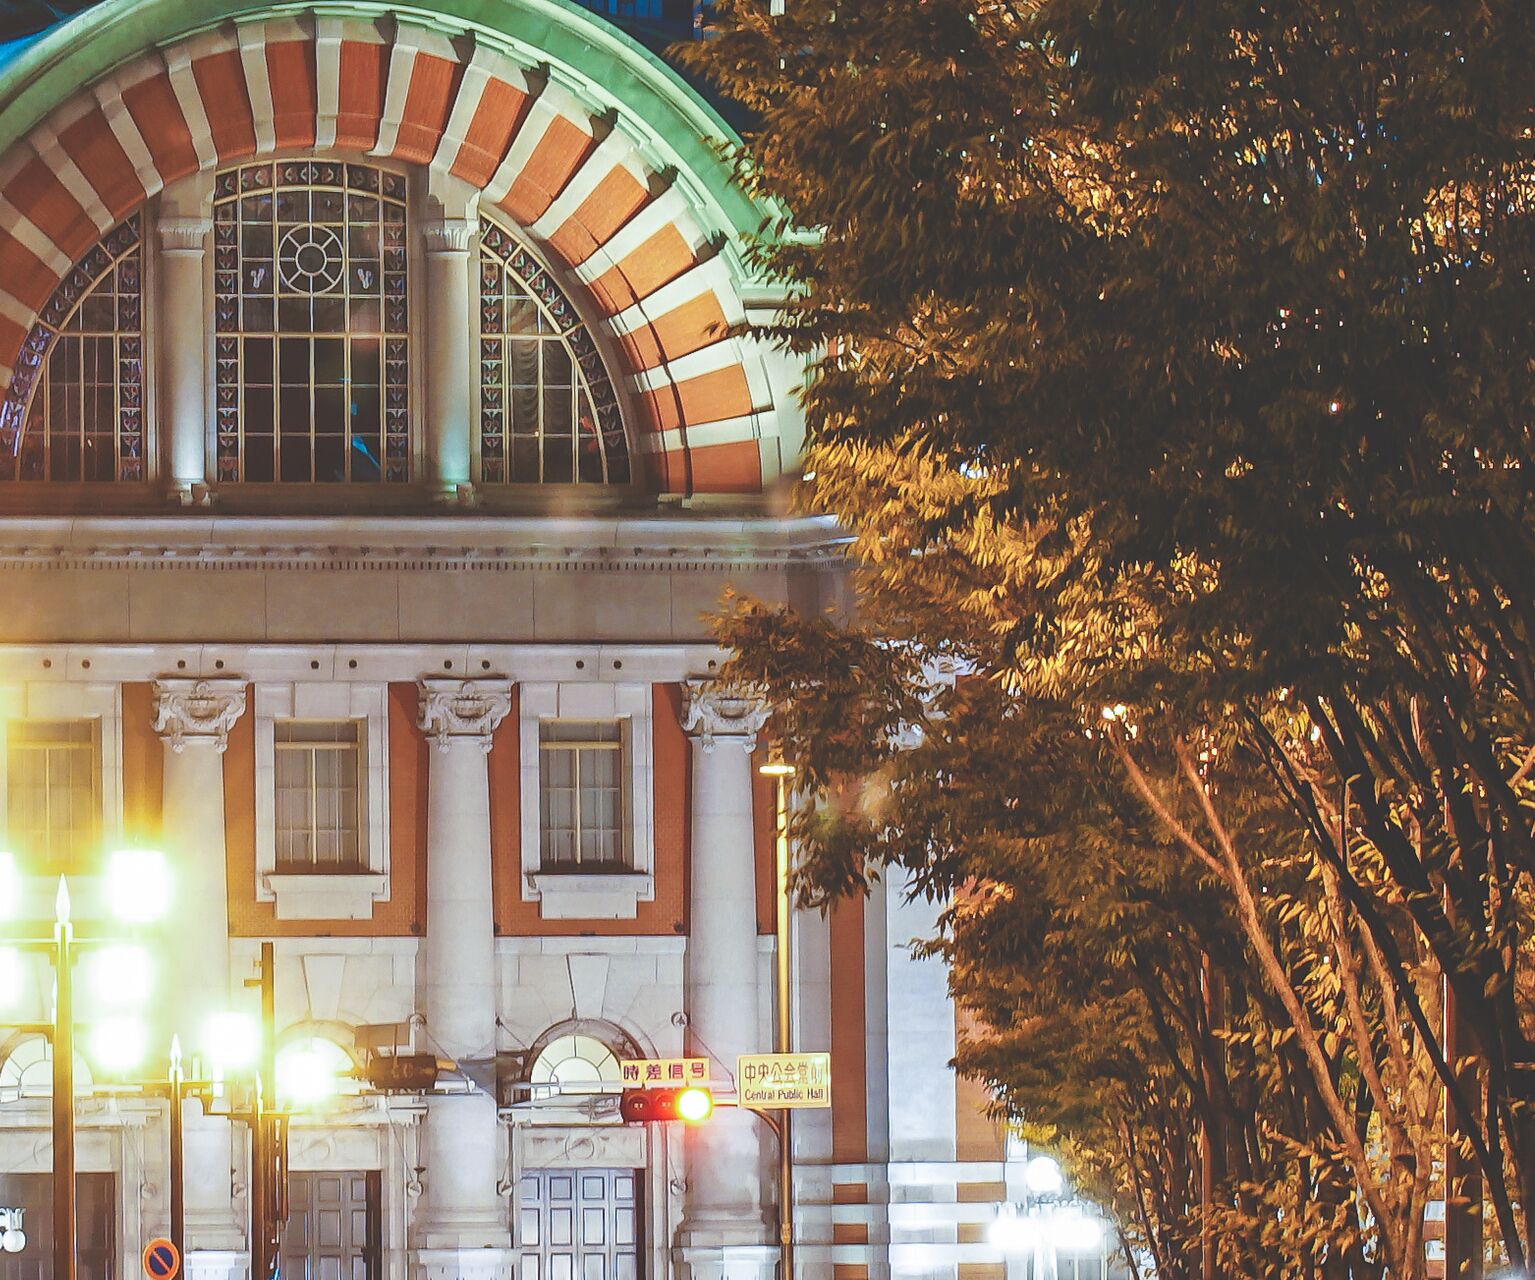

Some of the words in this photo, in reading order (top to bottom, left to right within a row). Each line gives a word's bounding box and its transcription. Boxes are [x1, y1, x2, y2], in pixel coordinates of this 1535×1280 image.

[623, 1062, 706, 1081] 時差信号
[744, 1088, 775, 1101] Central
[778, 1088, 804, 1101] Public
[807, 1087, 824, 1100] Hall
